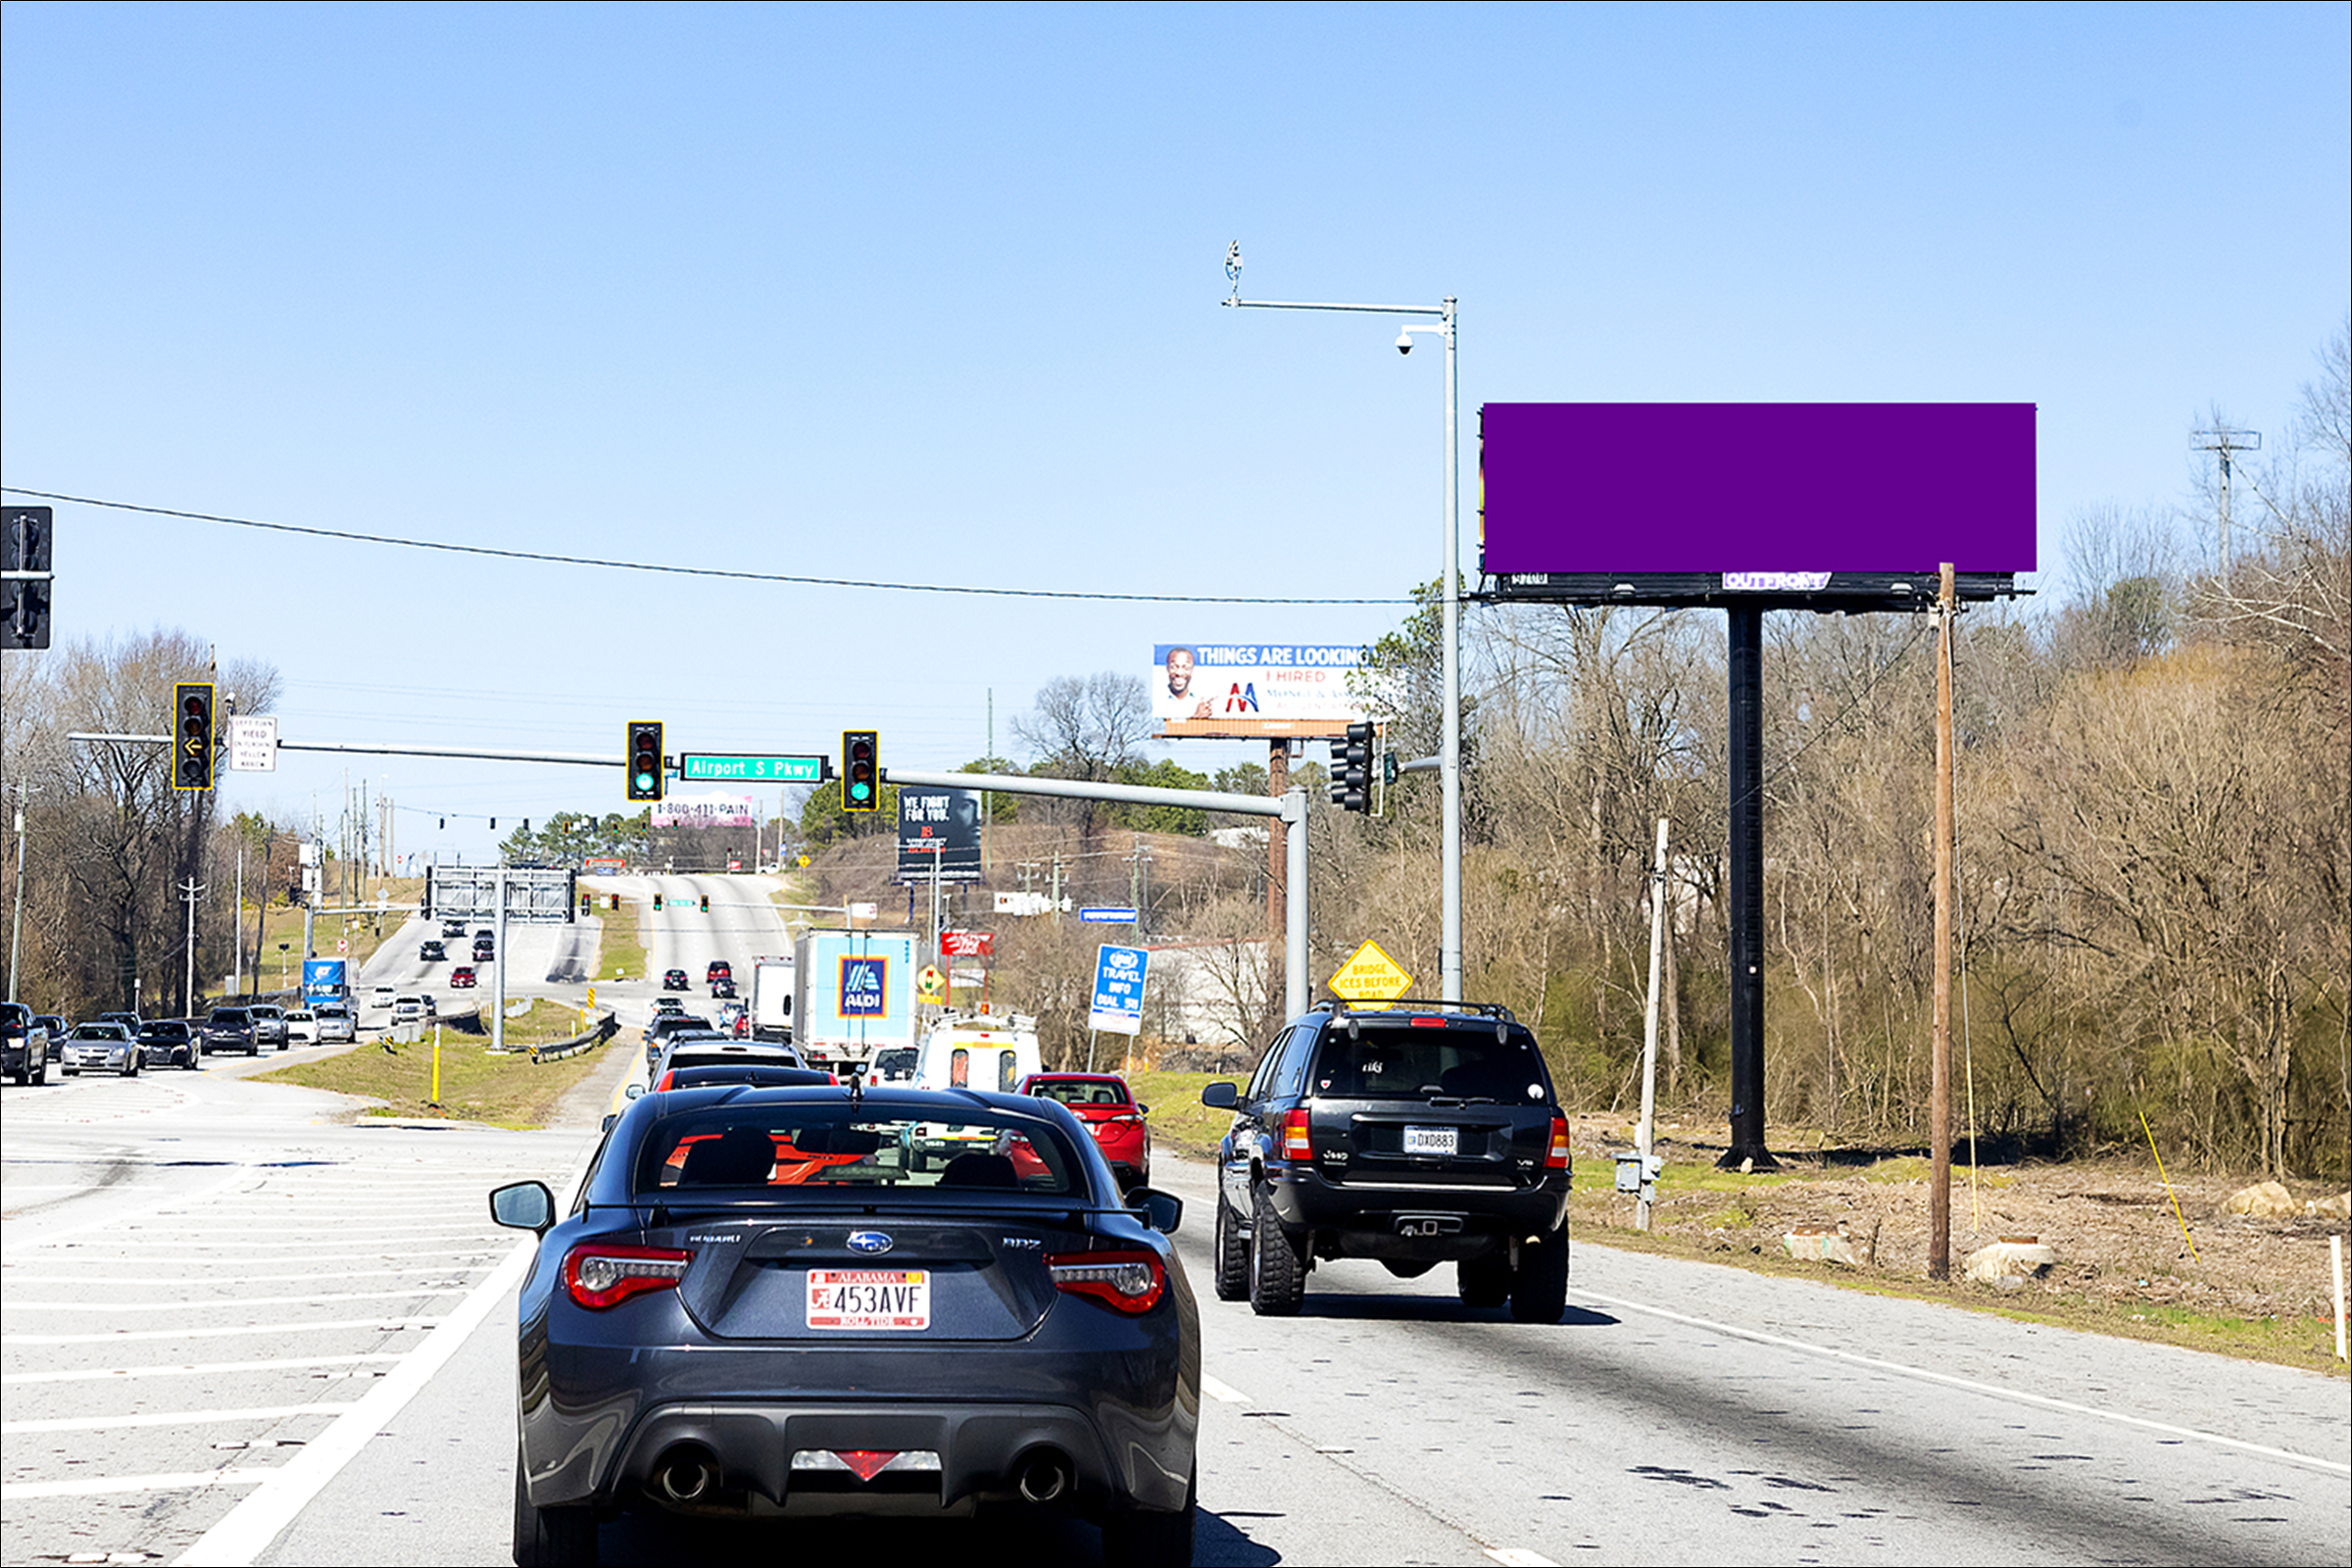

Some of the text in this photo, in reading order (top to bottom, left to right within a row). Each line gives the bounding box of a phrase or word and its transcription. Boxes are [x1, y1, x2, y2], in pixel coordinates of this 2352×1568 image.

[1726, 571, 1828, 589] OUTFRONT
[1198, 646, 1257, 665] THINGS
[1259, 646, 1294, 665] ARE
[1296, 647, 1370, 666] LOOKING
[1276, 670, 1326, 683] HIRED
[691, 759, 815, 780] Airport S Pkwy
[658, 803, 749, 816] 1-800-411-PAIN
[904, 795, 950, 810] WE FIGHT
[905, 808, 924, 822] FOR
[1102, 965, 1142, 984] TRAVEL
[1352, 962, 1388, 980] BRIDGE
[1108, 981, 1132, 996] INFO
[1339, 975, 1402, 990] ICES BEFORE
[844, 994, 880, 1007] ALDI
[1097, 993, 1119, 1007] DIAL
[1358, 989, 1386, 1000] ROAD
[838, 1272, 897, 1284] ALABAMA
[834, 1286, 922, 1314] 453AVF
